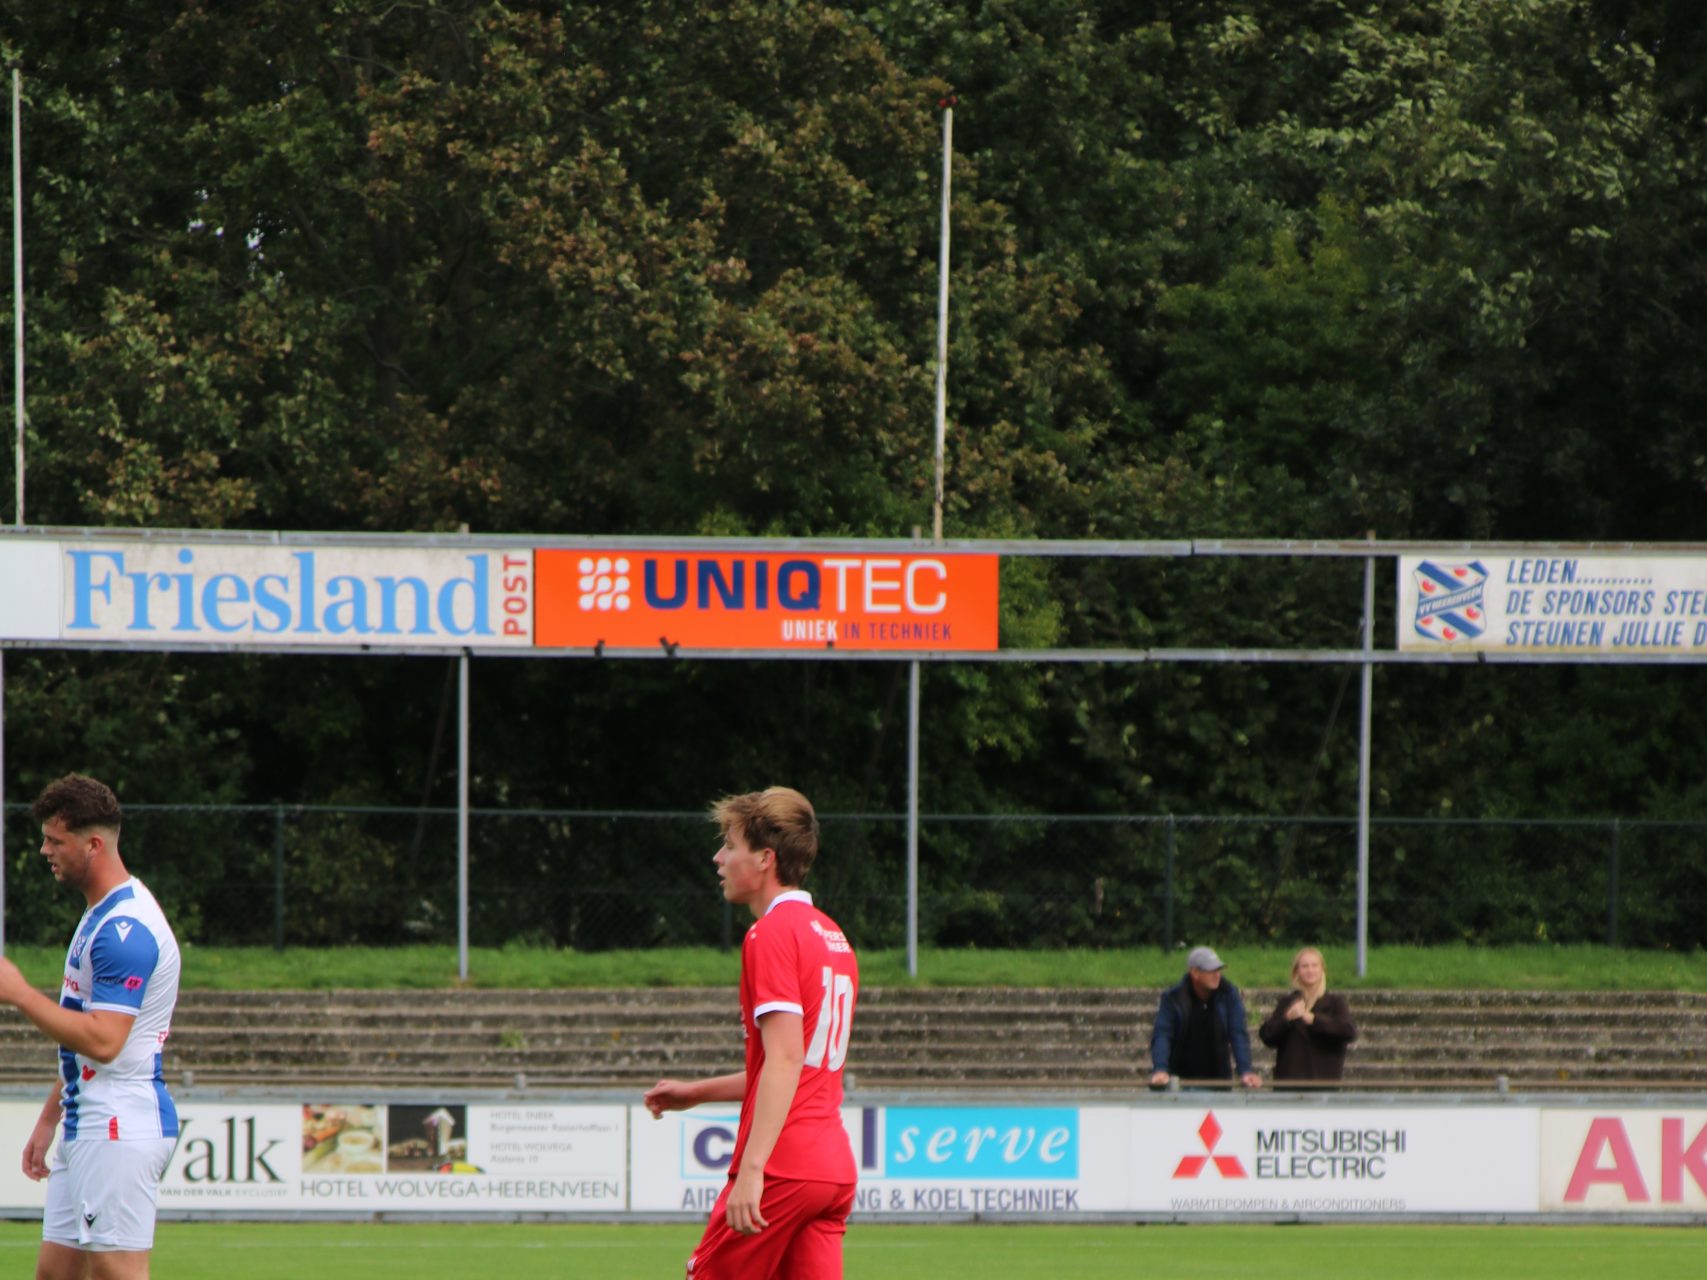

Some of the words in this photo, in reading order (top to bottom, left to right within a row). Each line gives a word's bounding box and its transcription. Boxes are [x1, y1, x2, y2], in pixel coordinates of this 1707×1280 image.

[65, 548, 495, 636] Friesland
[503, 554, 527, 636] POST
[644, 558, 947, 613] UNIQTEC
[1506, 590, 1534, 615] DE
[1542, 590, 1656, 615] SPONSORS
[782, 620, 838, 641] UNIEK
[844, 623, 859, 639] IN
[869, 623, 952, 641] TECHNIEK
[1506, 621, 1605, 646] STEUNEN
[1613, 621, 1685, 646] JULLIE
[804, 966, 854, 1072] 10
[894, 1125, 1070, 1163] serve
[1256, 1130, 1406, 1153] MITSUBISHI
[1256, 1156, 1386, 1179] ELECTRIC
[160, 1188, 181, 1197] VAN
[184, 1188, 204, 1197] DER
[206, 1188, 232, 1197] VALK
[300, 1180, 368, 1198] HOTEL
[376, 1180, 619, 1199] WOLVEGA-HEERENVEEN
[889, 1188, 905, 1210] &
[914, 1187, 1079, 1211] KOELTECHNIEK
[1171, 1199, 1280, 1211] WARMTEPOMPEN
[1293, 1199, 1406, 1211] AIRCONDITIONERS
